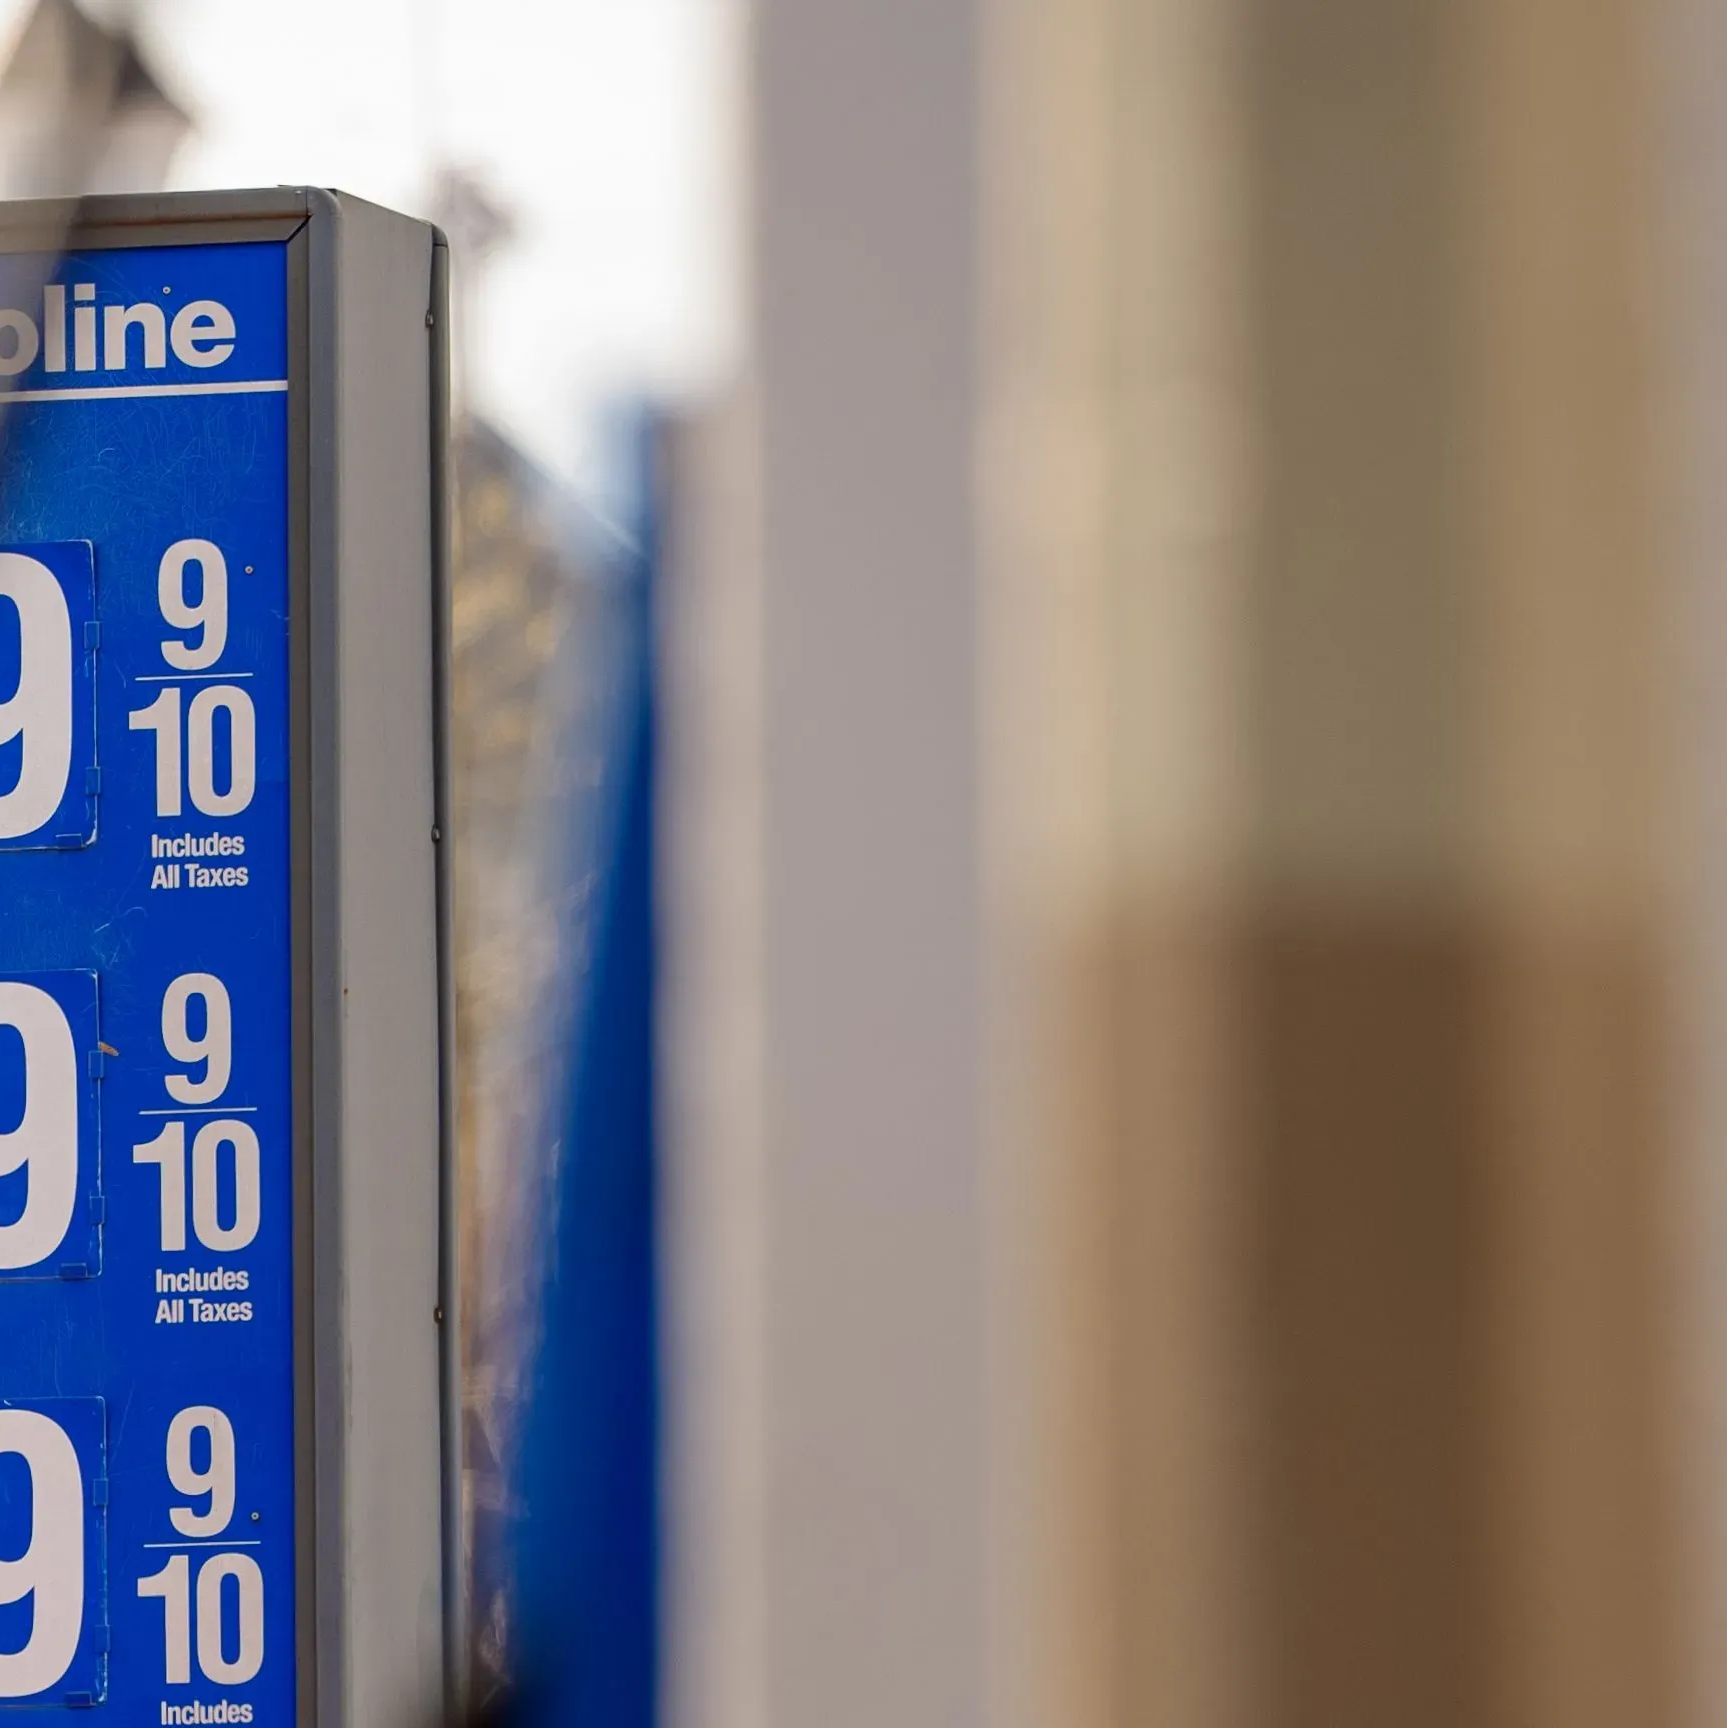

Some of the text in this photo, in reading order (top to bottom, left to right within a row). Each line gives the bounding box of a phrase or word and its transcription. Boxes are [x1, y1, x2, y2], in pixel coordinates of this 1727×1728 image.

[158, 538, 228, 671] 9
[128, 685, 256, 817] 10
[151, 832, 245, 858] Includes
[151, 863, 249, 889] All Taxes
[161, 972, 232, 1105] 9
[132, 1119, 261, 1252] 10
[155, 1266, 250, 1293] Includes
[155, 1299, 253, 1324] All Taxes
[166, 1405, 236, 1538] 9
[137, 1552, 264, 1686] 10
[161, 1700, 254, 1726] Includes
